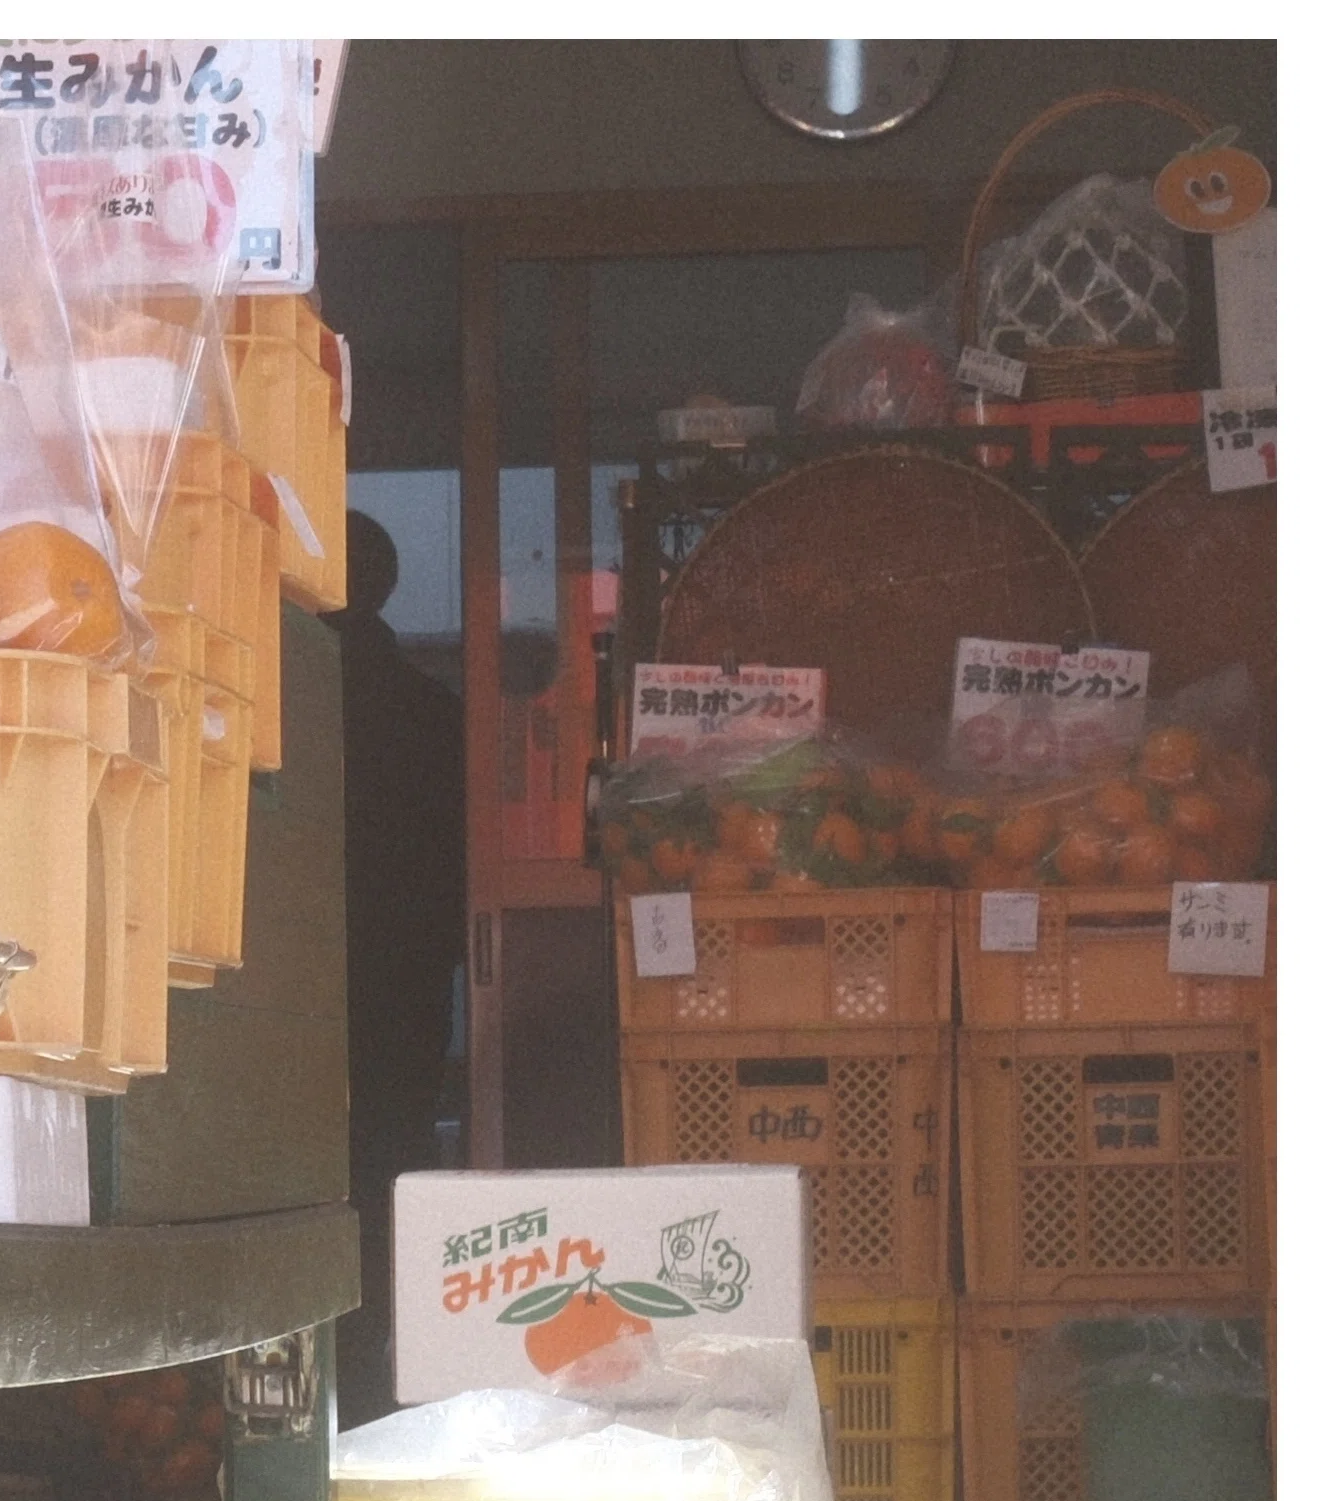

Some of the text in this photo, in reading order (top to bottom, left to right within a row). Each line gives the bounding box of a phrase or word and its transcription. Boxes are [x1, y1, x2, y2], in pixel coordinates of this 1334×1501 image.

[639, 686, 815, 718] 完熟ポンカン
[961, 663, 1141, 699] 完熟ポンカン
[442, 1206, 549, 1268] 紀南
[442, 1236, 606, 1314] みかん
